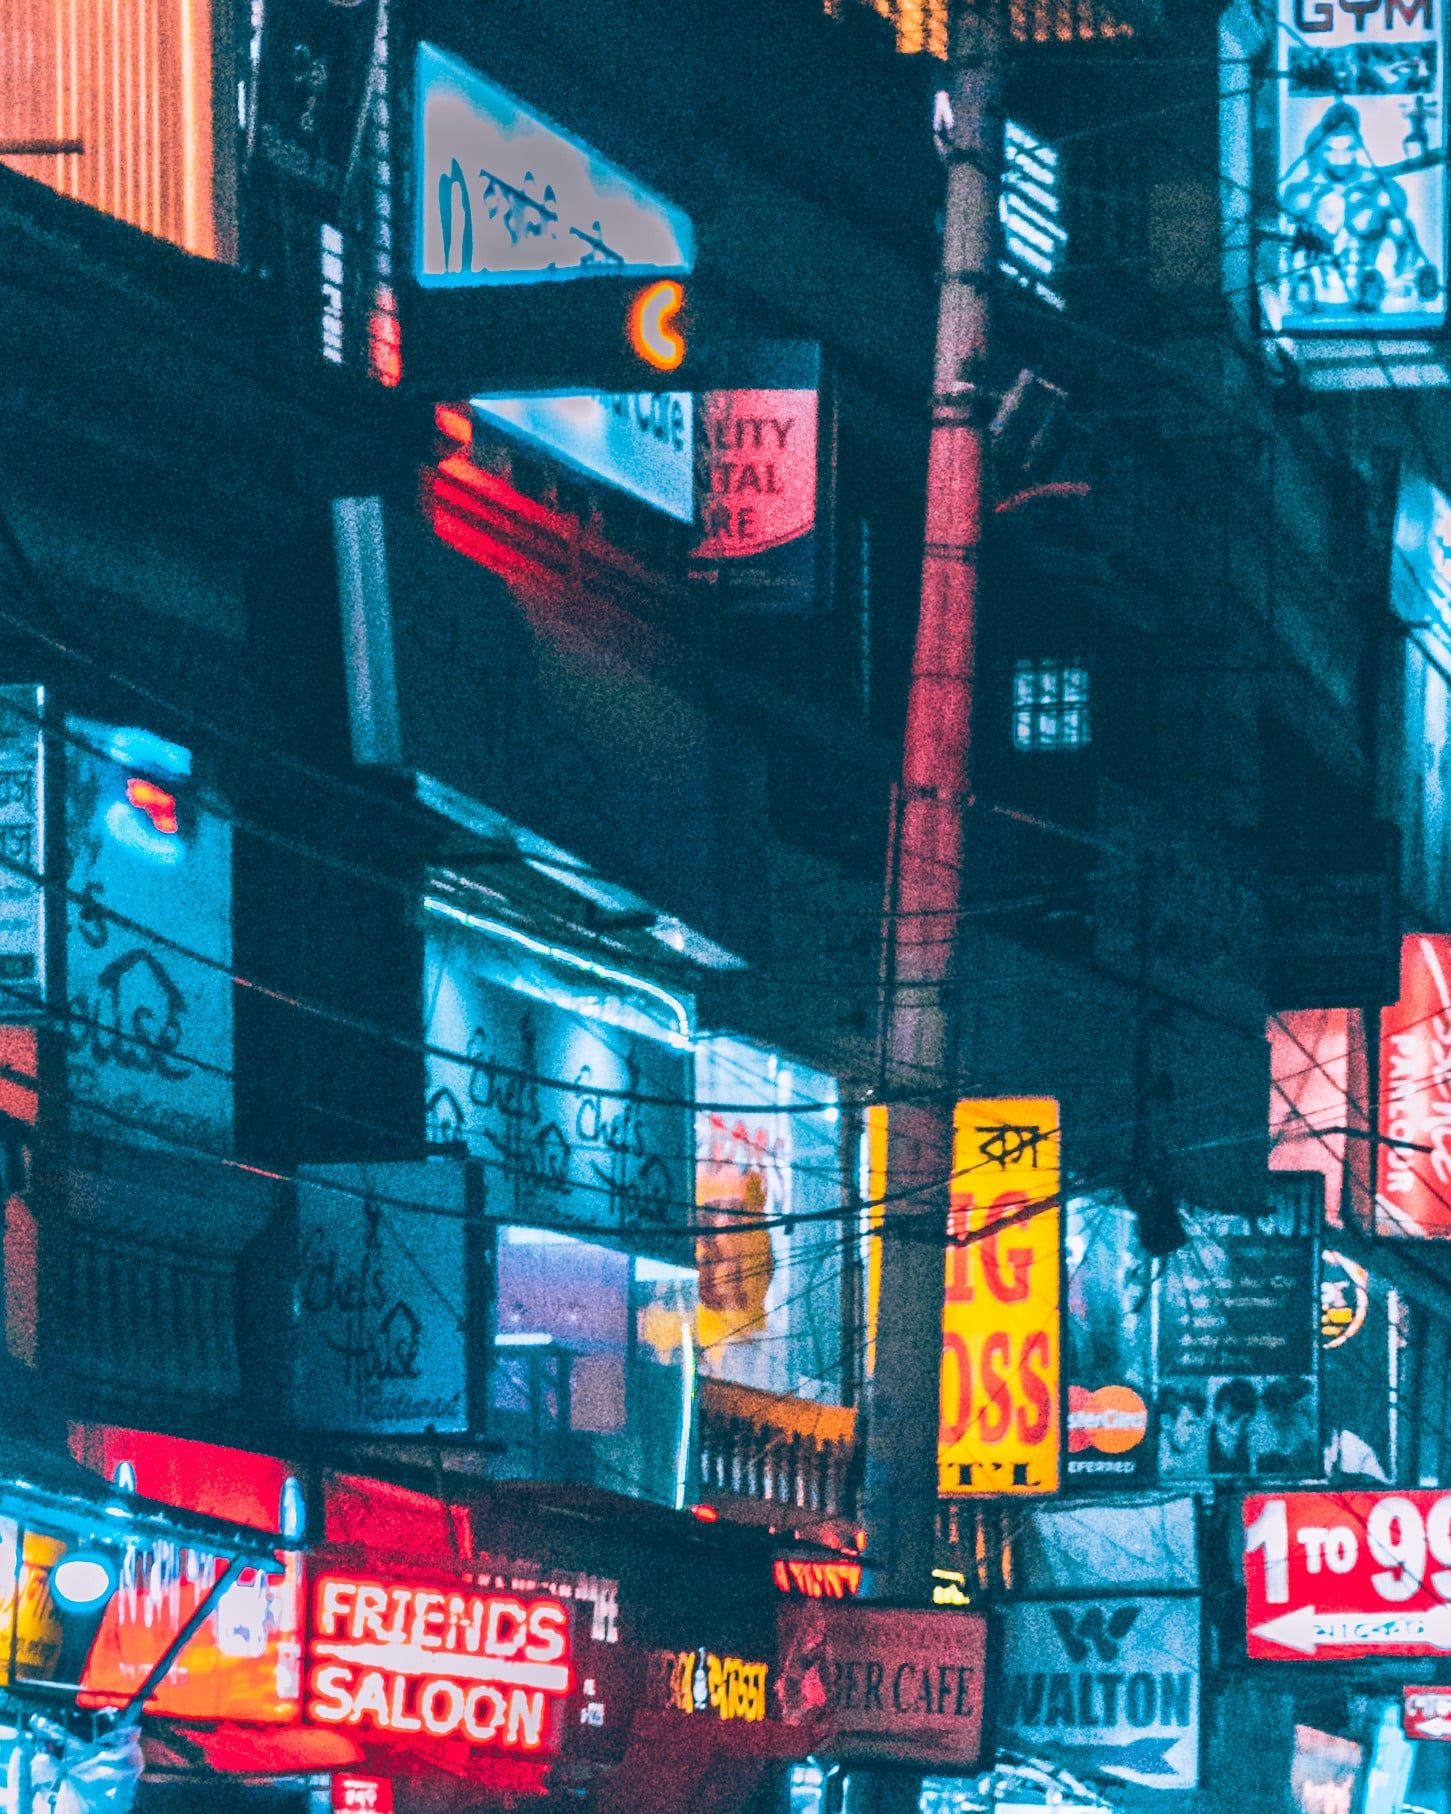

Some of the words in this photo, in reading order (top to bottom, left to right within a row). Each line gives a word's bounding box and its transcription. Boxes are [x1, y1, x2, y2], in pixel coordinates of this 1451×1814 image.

[1293, 0, 1434, 33] GYM
[1245, 1499, 1290, 1605] 1
[1296, 1526, 1359, 1574] TO
[322, 1582, 566, 1662] FRIENDS
[314, 1666, 545, 1746] SALOON
[891, 1660, 977, 1718] CAFE
[1000, 1671, 1191, 1729] WALTON
